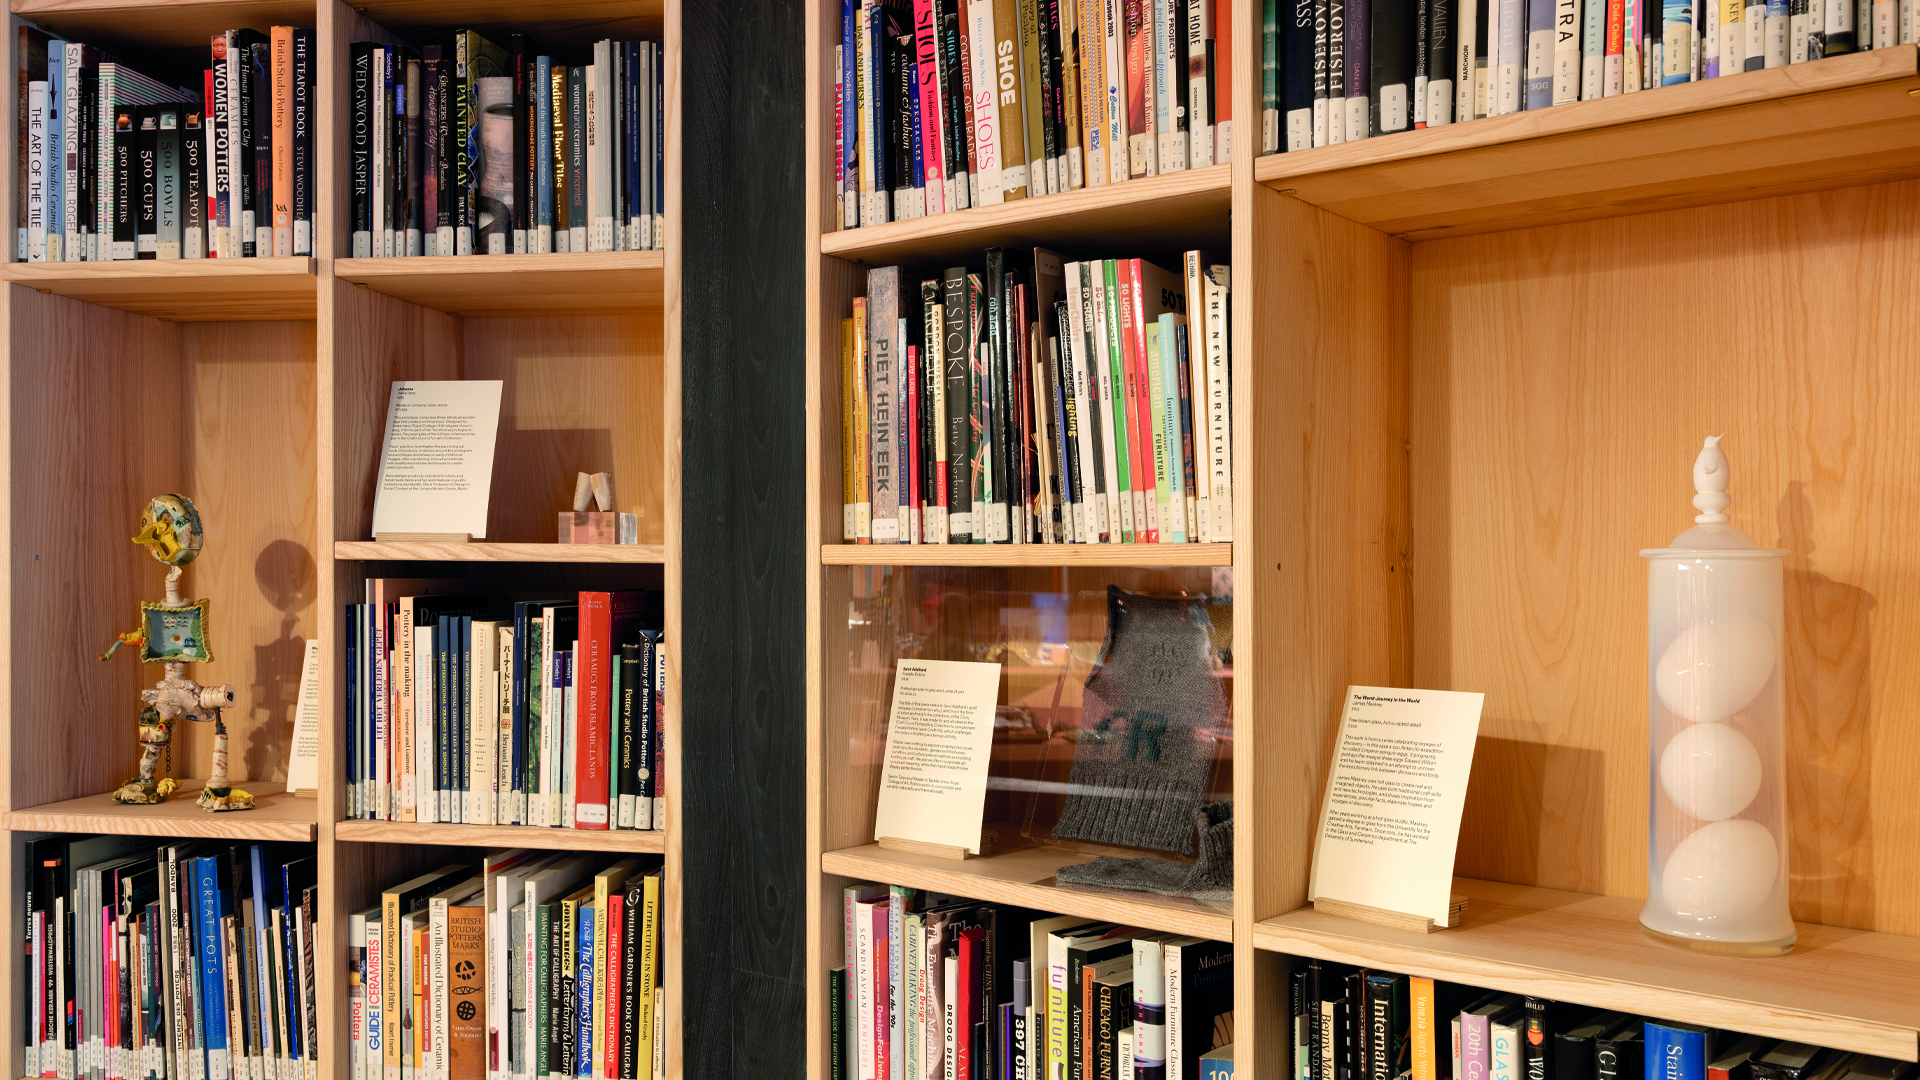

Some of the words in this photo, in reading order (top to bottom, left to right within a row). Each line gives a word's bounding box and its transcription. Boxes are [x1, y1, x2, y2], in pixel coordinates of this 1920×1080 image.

[1050, 2, 1058, 30] BAGS
[1612, 4, 1620, 21] Dale
[947, 30, 956, 64] SHOES
[1156, 8, 1165, 55] professional
[1190, 15, 1201, 46] HOME
[1610, 22, 1620, 52] Chihuly
[67, 48, 77, 81] SALT
[276, 39, 285, 66] British
[296, 37, 306, 59] THE
[917, 11, 936, 85] SHOES
[276, 68, 285, 96] Studio
[296, 62, 306, 102] TEAPOT
[901, 54, 911, 95] costume
[998, 39, 1016, 107] SHOE
[1156, 59, 1166, 94] approach
[215, 63, 227, 122] WOMEN
[355, 55, 367, 145] WEDGWOOD
[429, 86, 437, 114] Hands
[927, 90, 935, 118] Fashion
[31, 107, 41, 130] THE
[67, 87, 77, 151] GLAZING
[275, 98, 285, 129] Pottery
[296, 106, 306, 138] BOOK
[429, 118, 436, 127] in
[457, 85, 467, 149] PAINTED
[900, 109, 912, 149] fashion
[31, 133, 41, 156] ART
[425, 130, 437, 150] Clay
[976, 91, 995, 170] SHOES
[118, 146, 128, 167] 500
[141, 150, 153, 178] 500
[161, 142, 173, 169] 500
[217, 128, 228, 192] POTTERS
[929, 134, 937, 162] Fantasy
[31, 160, 41, 178] OF
[355, 148, 367, 195] JASPER
[457, 152, 467, 188] CLAY
[31, 181, 41, 202] THE
[120, 170, 129, 223] PITCHERS
[143, 183, 154, 221] CUPS
[163, 175, 173, 227] BOWLS
[574, 168, 582, 205] vincentelli
[31, 206, 41, 228] TILE
[1082, 287, 1089, 299] 50
[1121, 284, 1128, 295] 50
[1211, 290, 1221, 319] THE
[1084, 301, 1092, 332] CHAIRS
[1122, 298, 1131, 328] LIGHTS
[946, 277, 964, 389] BESPOKE
[1213, 332, 1221, 366] NEW
[876, 339, 888, 385] PIET
[1150, 351, 1163, 408] american
[877, 393, 888, 443] HEIN
[951, 417, 963, 446] Betty
[1066, 397, 1077, 437] lighting
[1214, 380, 1223, 477] FURNITURE
[877, 451, 888, 492] EEK
[1156, 433, 1164, 481] FURNITURE
[952, 453, 963, 506] Norbury
[402, 609, 410, 638] Pottery
[404, 640, 411, 648] in
[402, 666, 411, 697] making
[623, 689, 632, 716] Pottery
[589, 750, 597, 778] LANDS
[624, 735, 632, 769] Ceramics
[203, 877, 215, 925] GREAT
[387, 902, 395, 929] Illustrated
[387, 931, 395, 958] Dictionary
[644, 901, 653, 962] LETTERCUTTING
[206, 935, 217, 974] POTS
[644, 963, 651, 971] IN
[985, 954, 991, 962] by
[369, 940, 380, 1004] CERAMISTES
[387, 993, 395, 1012] Pottery
[1052, 965, 1066, 1057] furniture
[1100, 986, 1111, 1039] CHICAGO
[1418, 996, 1427, 1029] Venezia
[353, 1002, 362, 1040] Potters
[369, 1011, 380, 1050] GUIDE
[1074, 1005, 1082, 1057] American
[608, 1016, 616, 1063] DICTIONARY
[1417, 1032, 1427, 1058] Aperto
[1468, 1024, 1482, 1055] 20th
